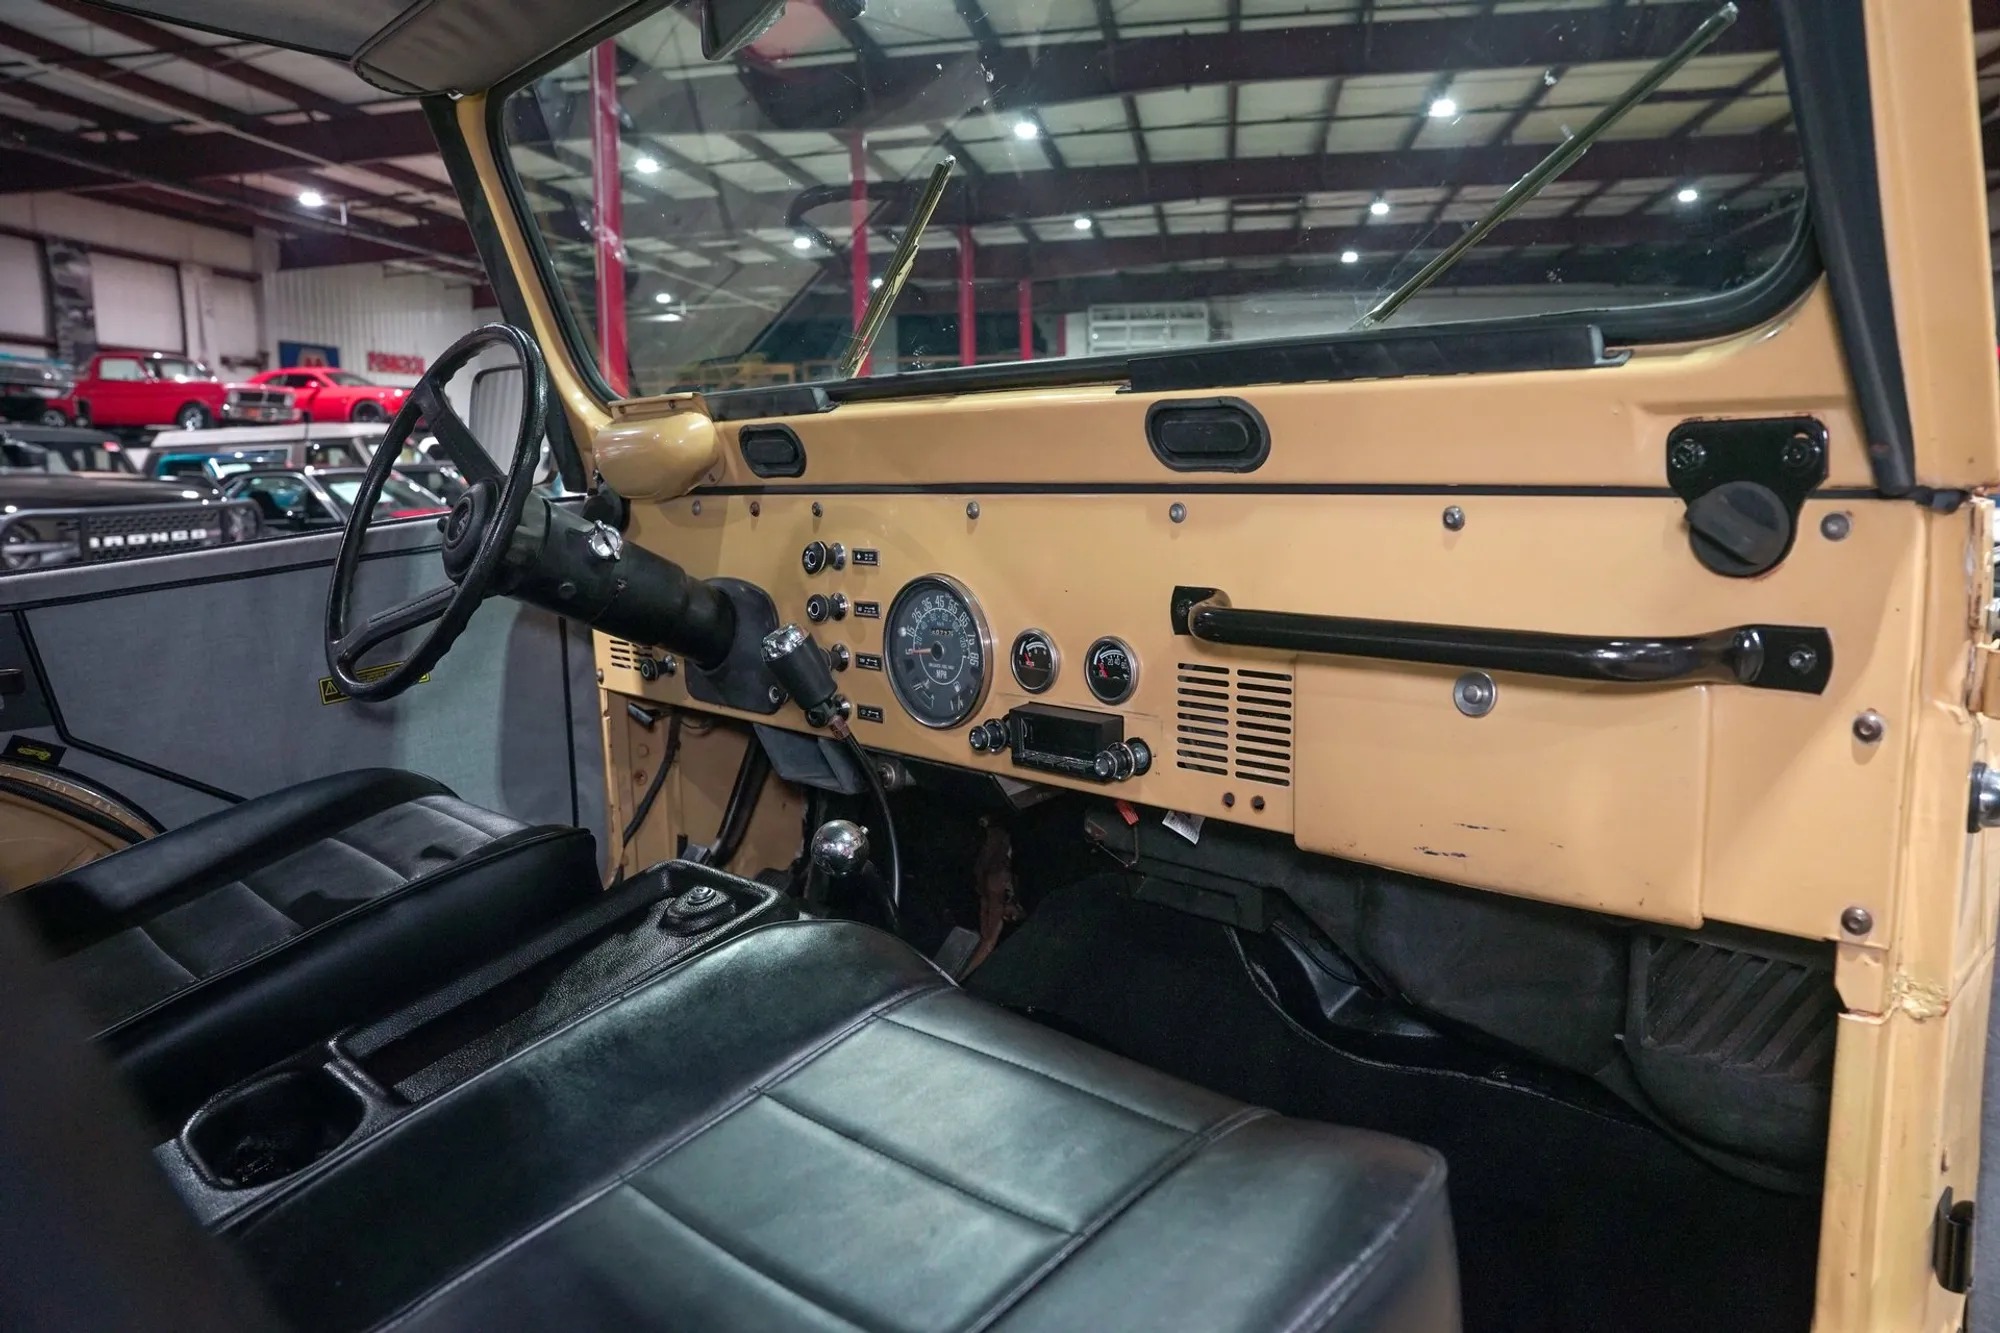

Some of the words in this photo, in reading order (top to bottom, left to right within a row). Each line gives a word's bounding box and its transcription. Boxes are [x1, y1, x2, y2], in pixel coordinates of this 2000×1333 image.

[921, 597, 933, 611] 35
[935, 595, 945, 608] 45
[948, 599, 959, 614] 55
[911, 607, 922, 623] 25
[959, 611, 970, 627] 65
[906, 625, 915, 637] 15
[967, 633, 976, 646] 75
[969, 652, 979, 667] 85
